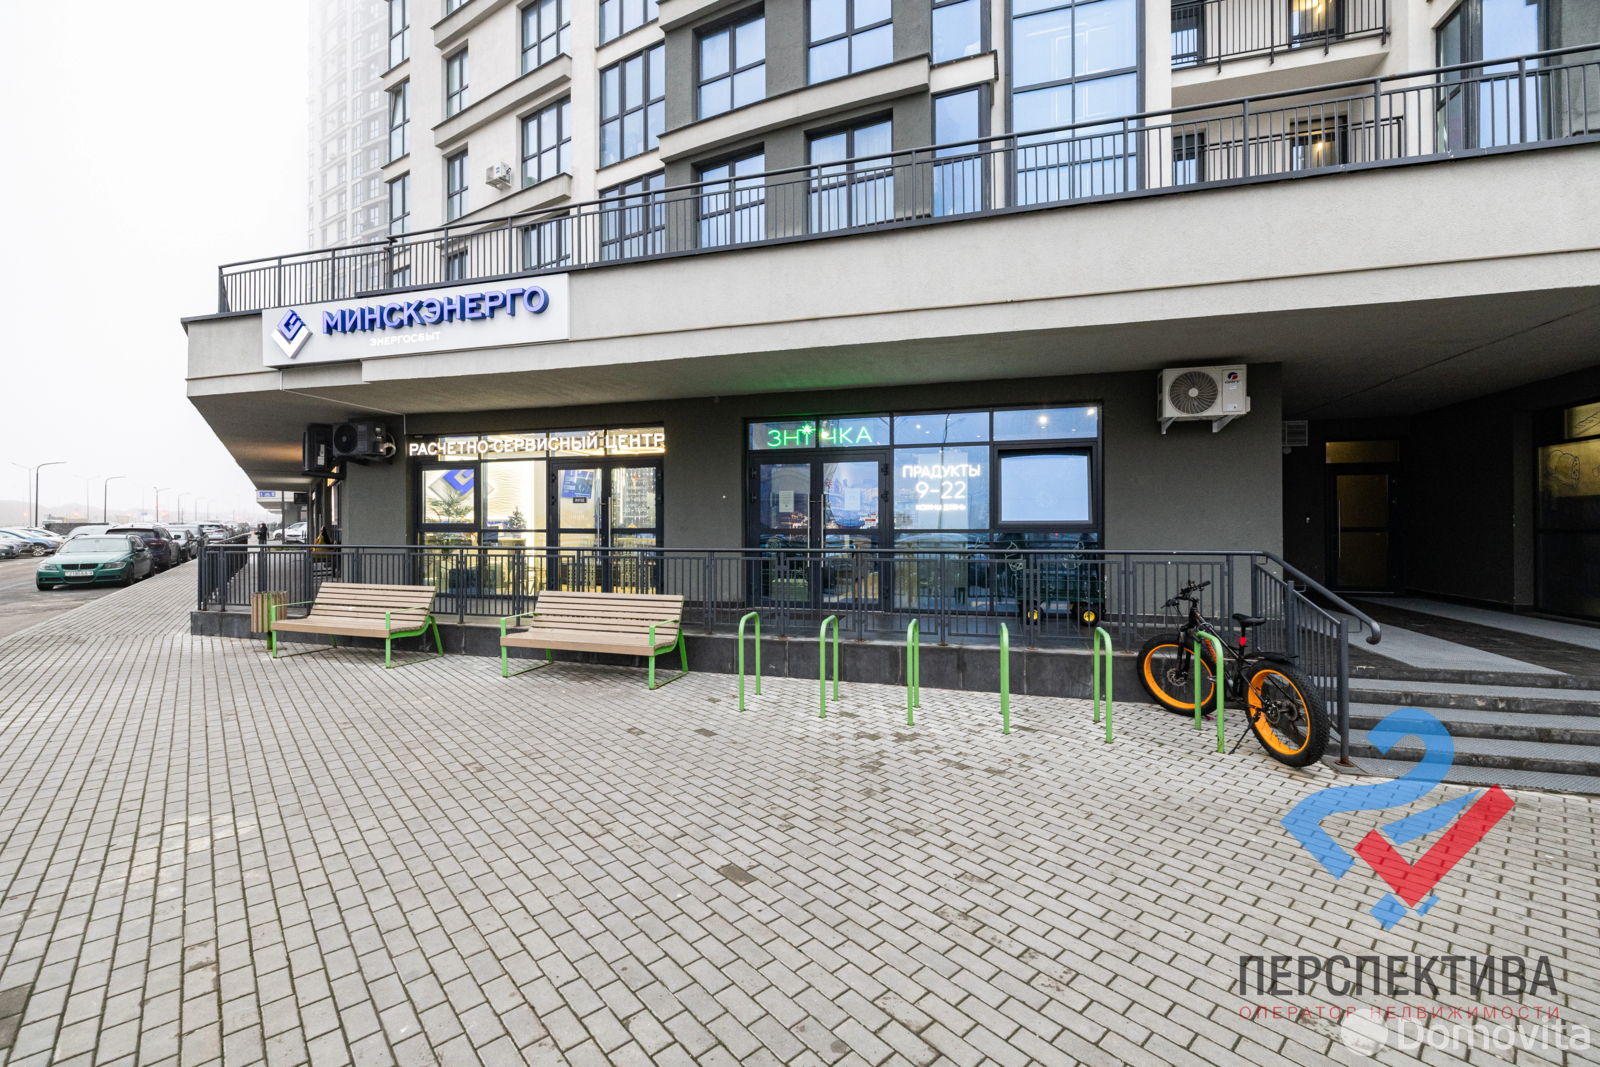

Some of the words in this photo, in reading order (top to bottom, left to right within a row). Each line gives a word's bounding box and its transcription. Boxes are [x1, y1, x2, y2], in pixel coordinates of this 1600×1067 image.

[322, 286, 549, 334] МИНСКЭНЕРГО
[369, 331, 441, 347] ЭНЕРГОСБЫТ
[409, 431, 598, 456] РАСЧЕТНО-СЕРВИСНЫЙ
[605, 433, 665, 451] ЦЕНТР
[902, 464, 981, 479] ПРАДУКТЫ
